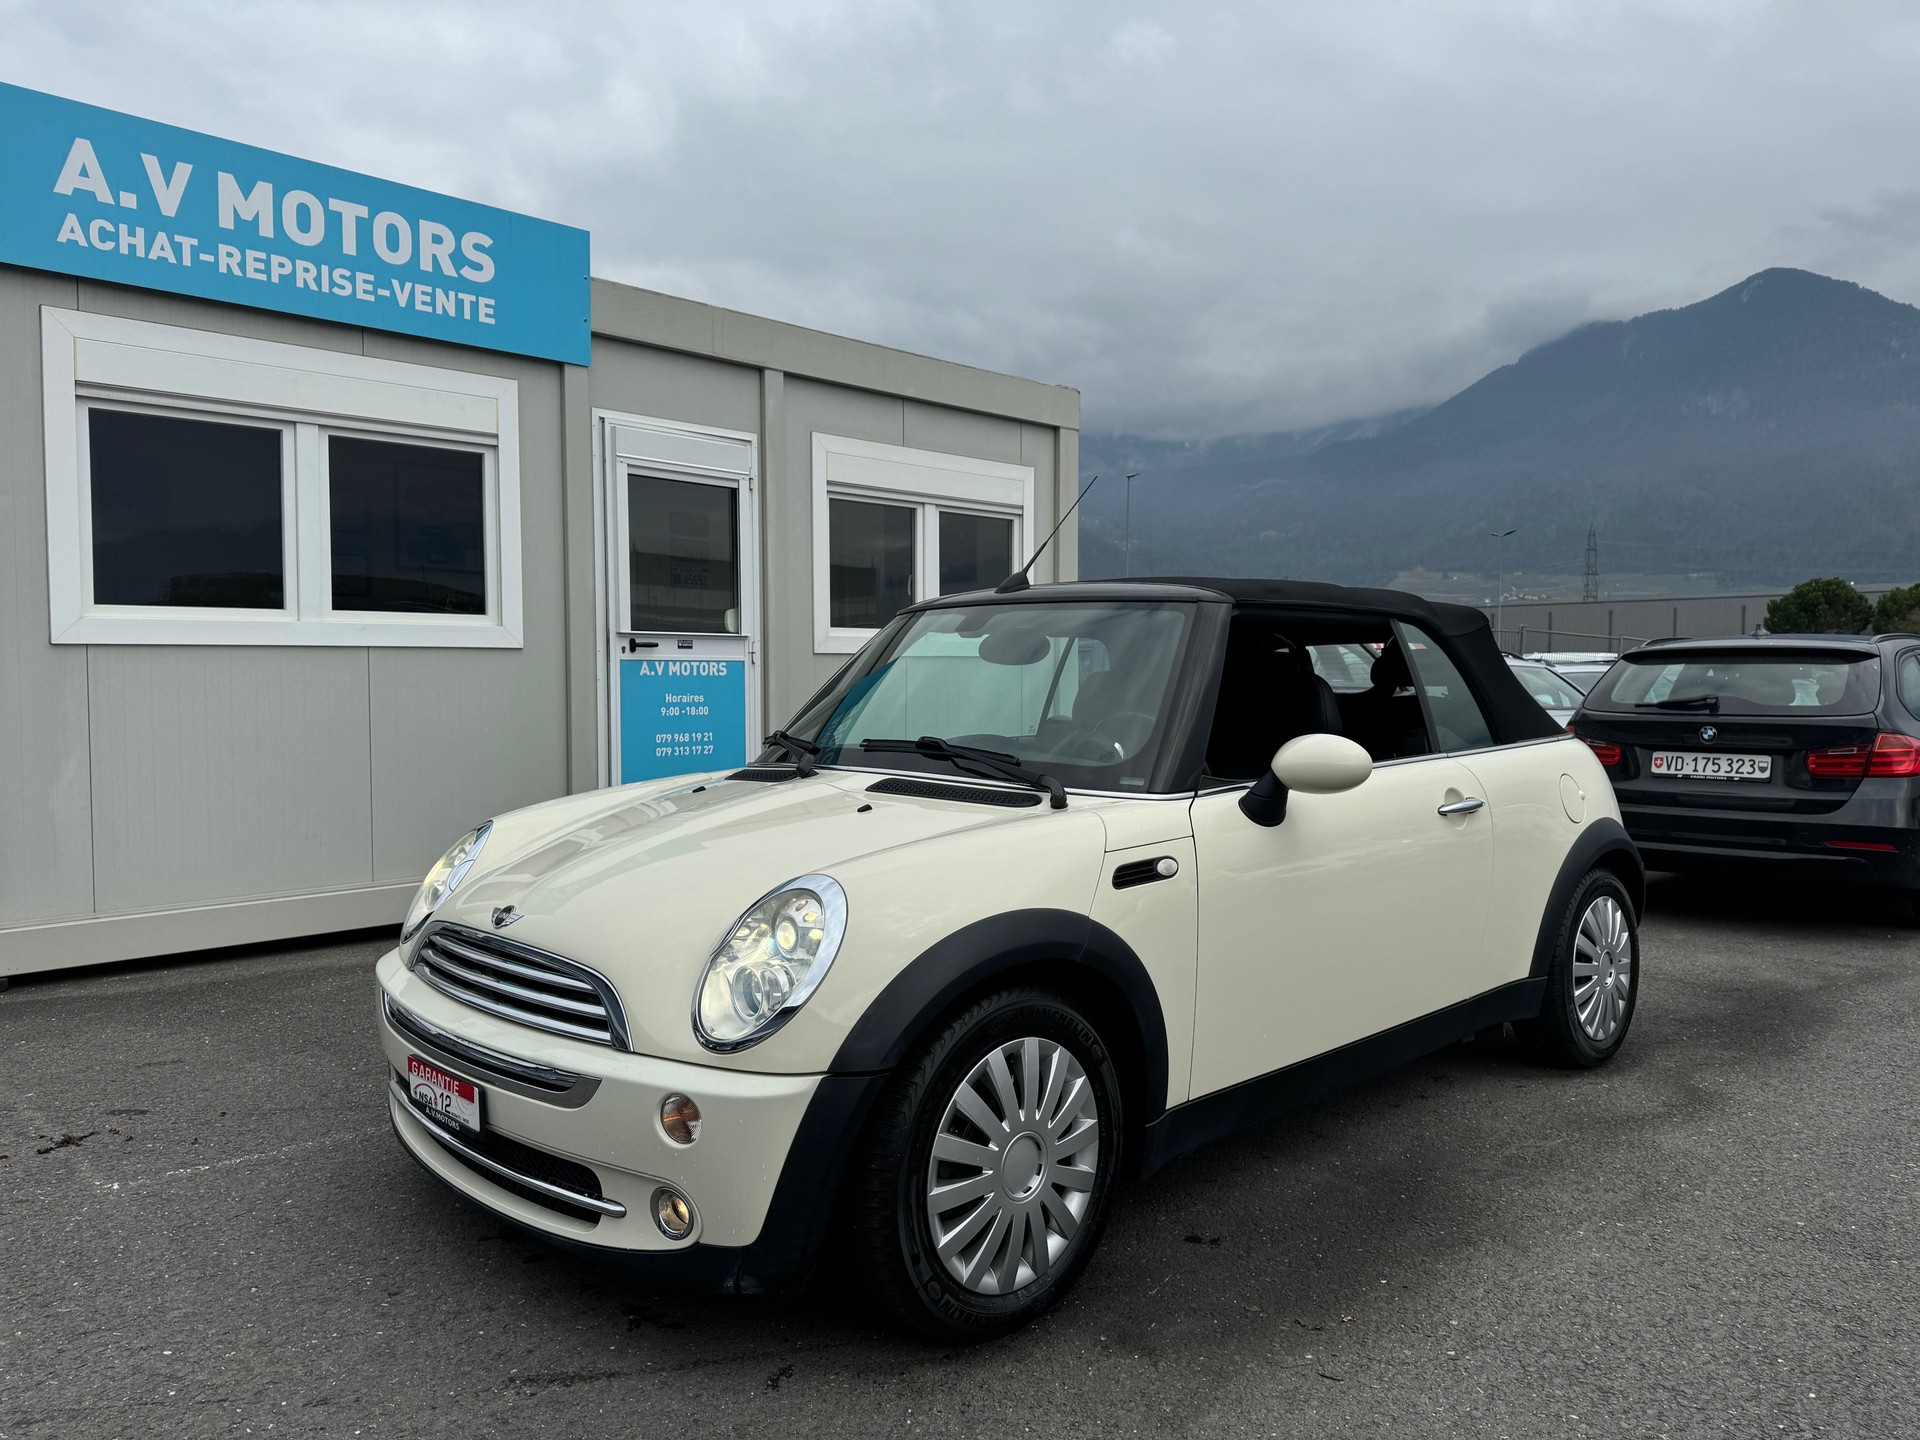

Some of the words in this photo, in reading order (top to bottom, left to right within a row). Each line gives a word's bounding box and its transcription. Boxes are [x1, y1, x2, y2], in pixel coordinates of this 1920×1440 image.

[53, 137, 193, 218] A.V
[217, 171, 496, 283] MOTORS
[56, 213, 496, 325] ACHAT-REPRISE-VENTE
[640, 661, 664, 675] A.V
[669, 662, 727, 676] MOTORS
[665, 693, 704, 703] Horaires
[660, 707, 680, 716] 9:00
[655, 734, 672, 743] 079
[673, 733, 690, 742] 968
[692, 733, 702, 742] 19
[703, 732, 713, 741] 21
[655, 747, 672, 757] 079
[673, 747, 690, 756] 313
[692, 746, 702, 755] 17
[703, 745, 714, 754] 27
[412, 1062, 459, 1095] GARANTIE
[439, 1092, 452, 1115] 12
